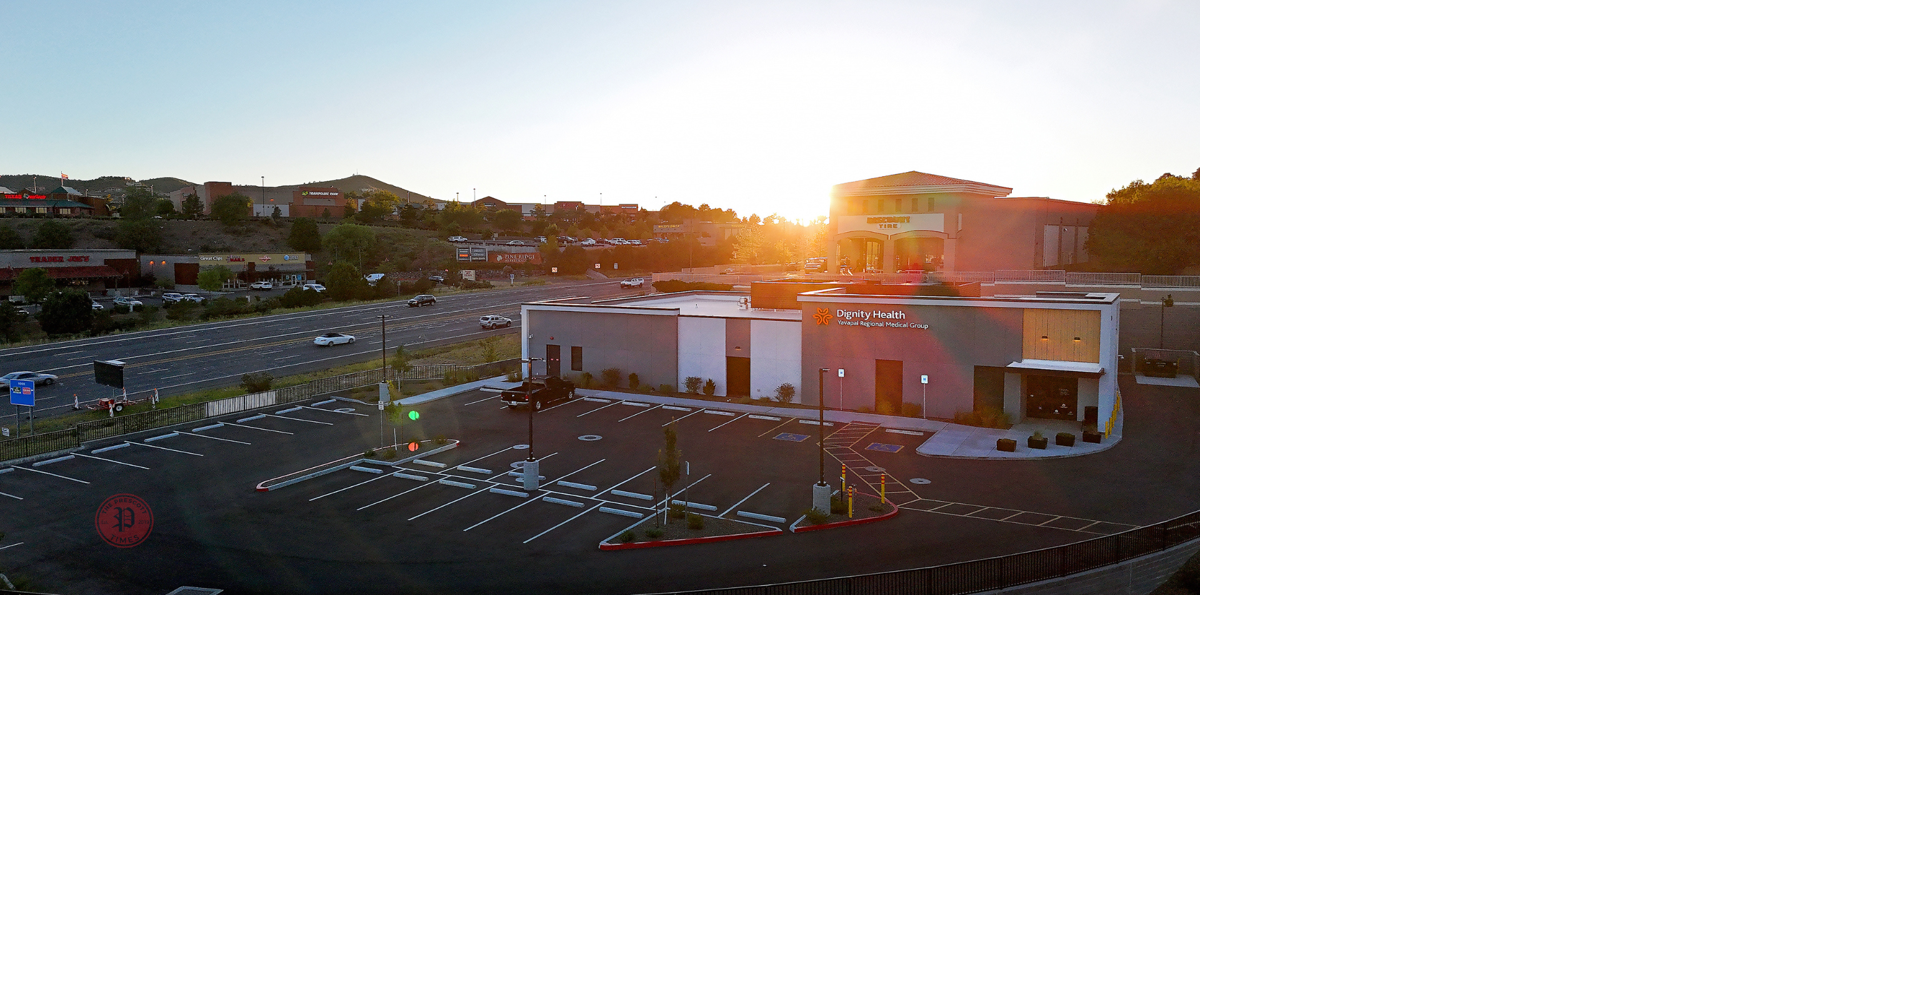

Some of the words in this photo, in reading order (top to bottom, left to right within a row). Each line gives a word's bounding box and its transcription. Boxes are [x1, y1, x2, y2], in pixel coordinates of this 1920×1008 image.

[836, 309, 871, 320] Dignity
[873, 310, 906, 320] Health
[860, 320, 884, 328] Regional
[885, 321, 908, 329] Medical
[909, 322, 929, 330] Group
